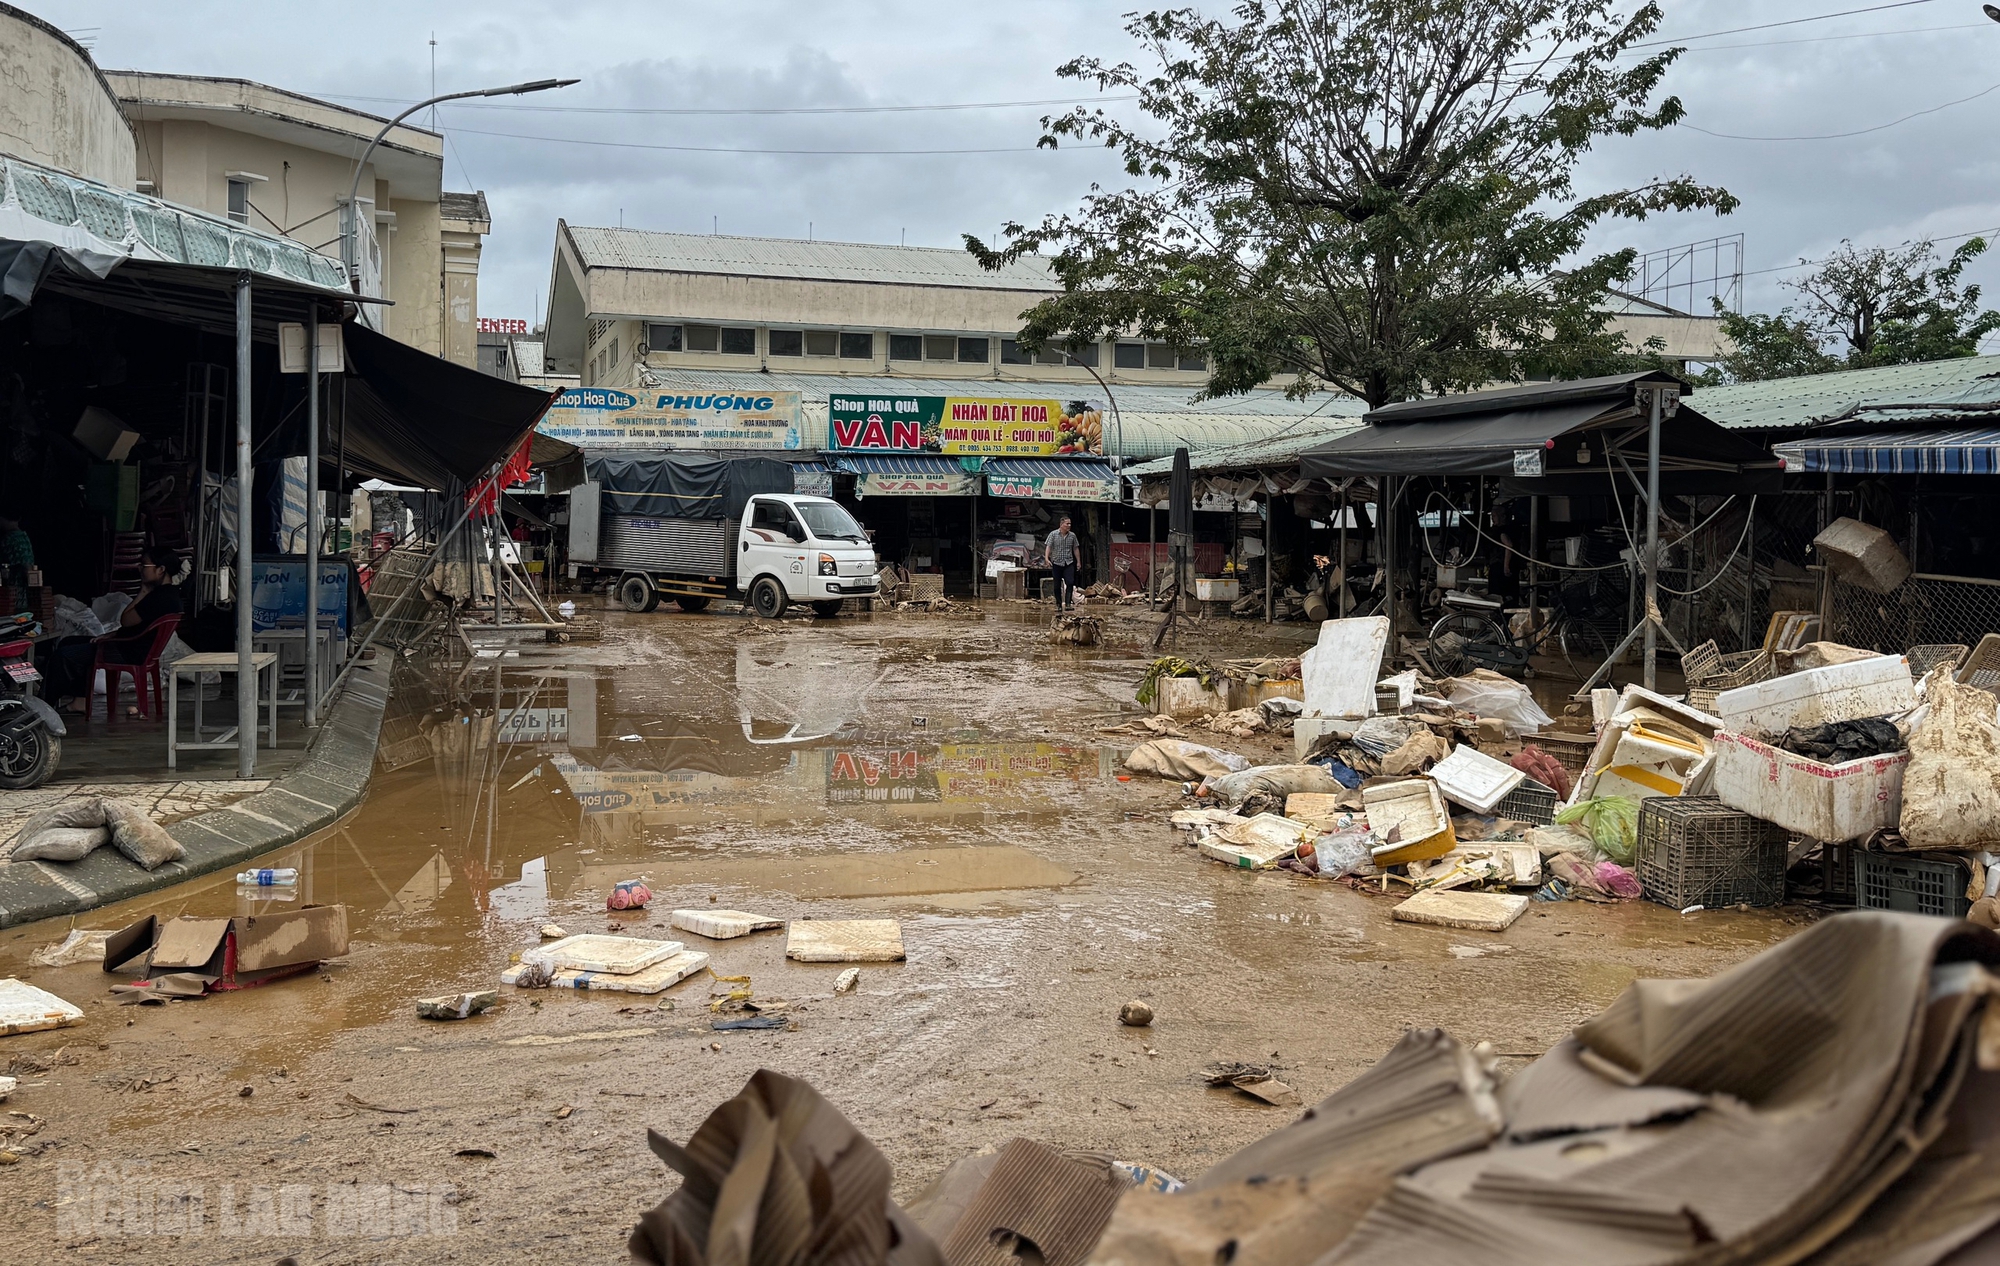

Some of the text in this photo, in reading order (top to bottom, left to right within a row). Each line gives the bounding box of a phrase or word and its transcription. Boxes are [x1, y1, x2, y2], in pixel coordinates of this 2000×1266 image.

[584, 391, 605, 405] Hoa
[608, 393, 631, 406] Quả
[656, 394, 774, 414] PHƯỢNG
[833, 398, 919, 413] Shop HOA QUẢ
[952, 402, 1048, 424] NHẬN ĐẶT HOA
[585, 429, 597, 437] HOA
[598, 429, 616, 437] TRANG
[834, 415, 921, 450] VÂN
[945, 427, 968, 441] MÂM
[971, 426, 990, 442] QUẢ
[876, 480, 949, 490] VÂN
[989, 482, 1033, 497] VÂN
[264, 572, 290, 584] ION
[321, 573, 347, 585] ION
[252, 609, 277, 618] OCARI
